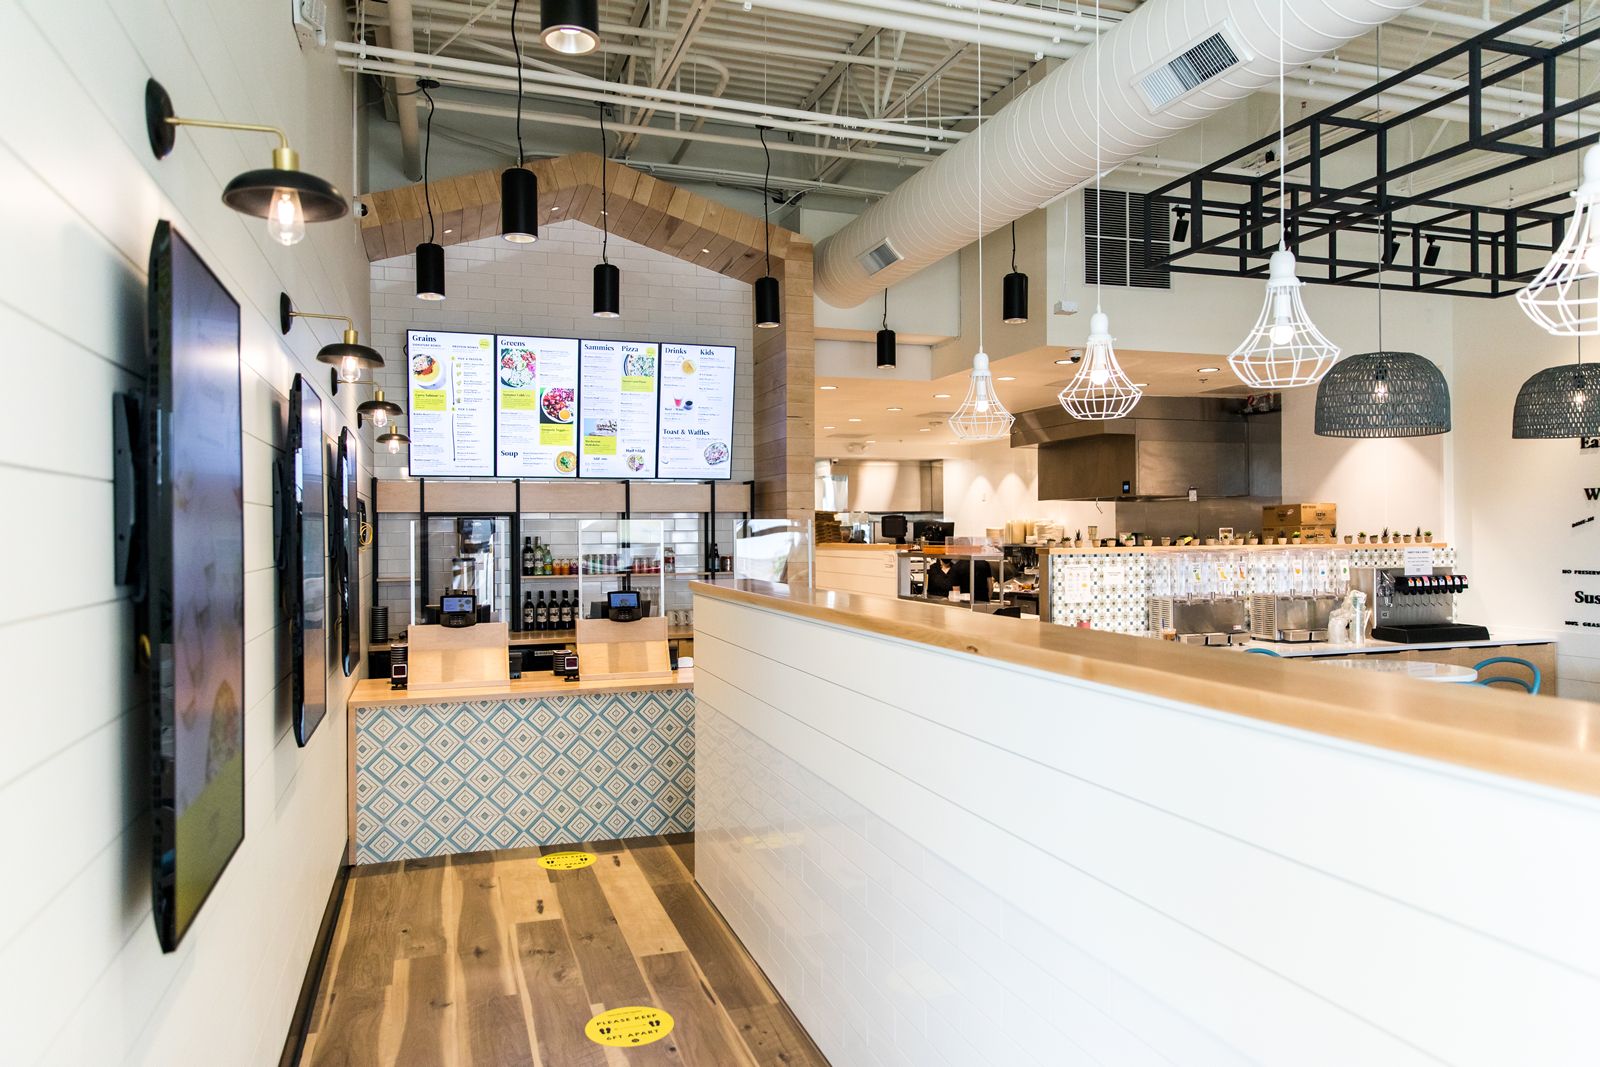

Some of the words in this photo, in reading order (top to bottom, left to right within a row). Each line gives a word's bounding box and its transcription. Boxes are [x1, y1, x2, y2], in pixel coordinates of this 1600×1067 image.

[500, 450, 519, 458] Soup
[596, 1017, 630, 1026] PLEASE
[628, 1029, 659, 1037] APART
